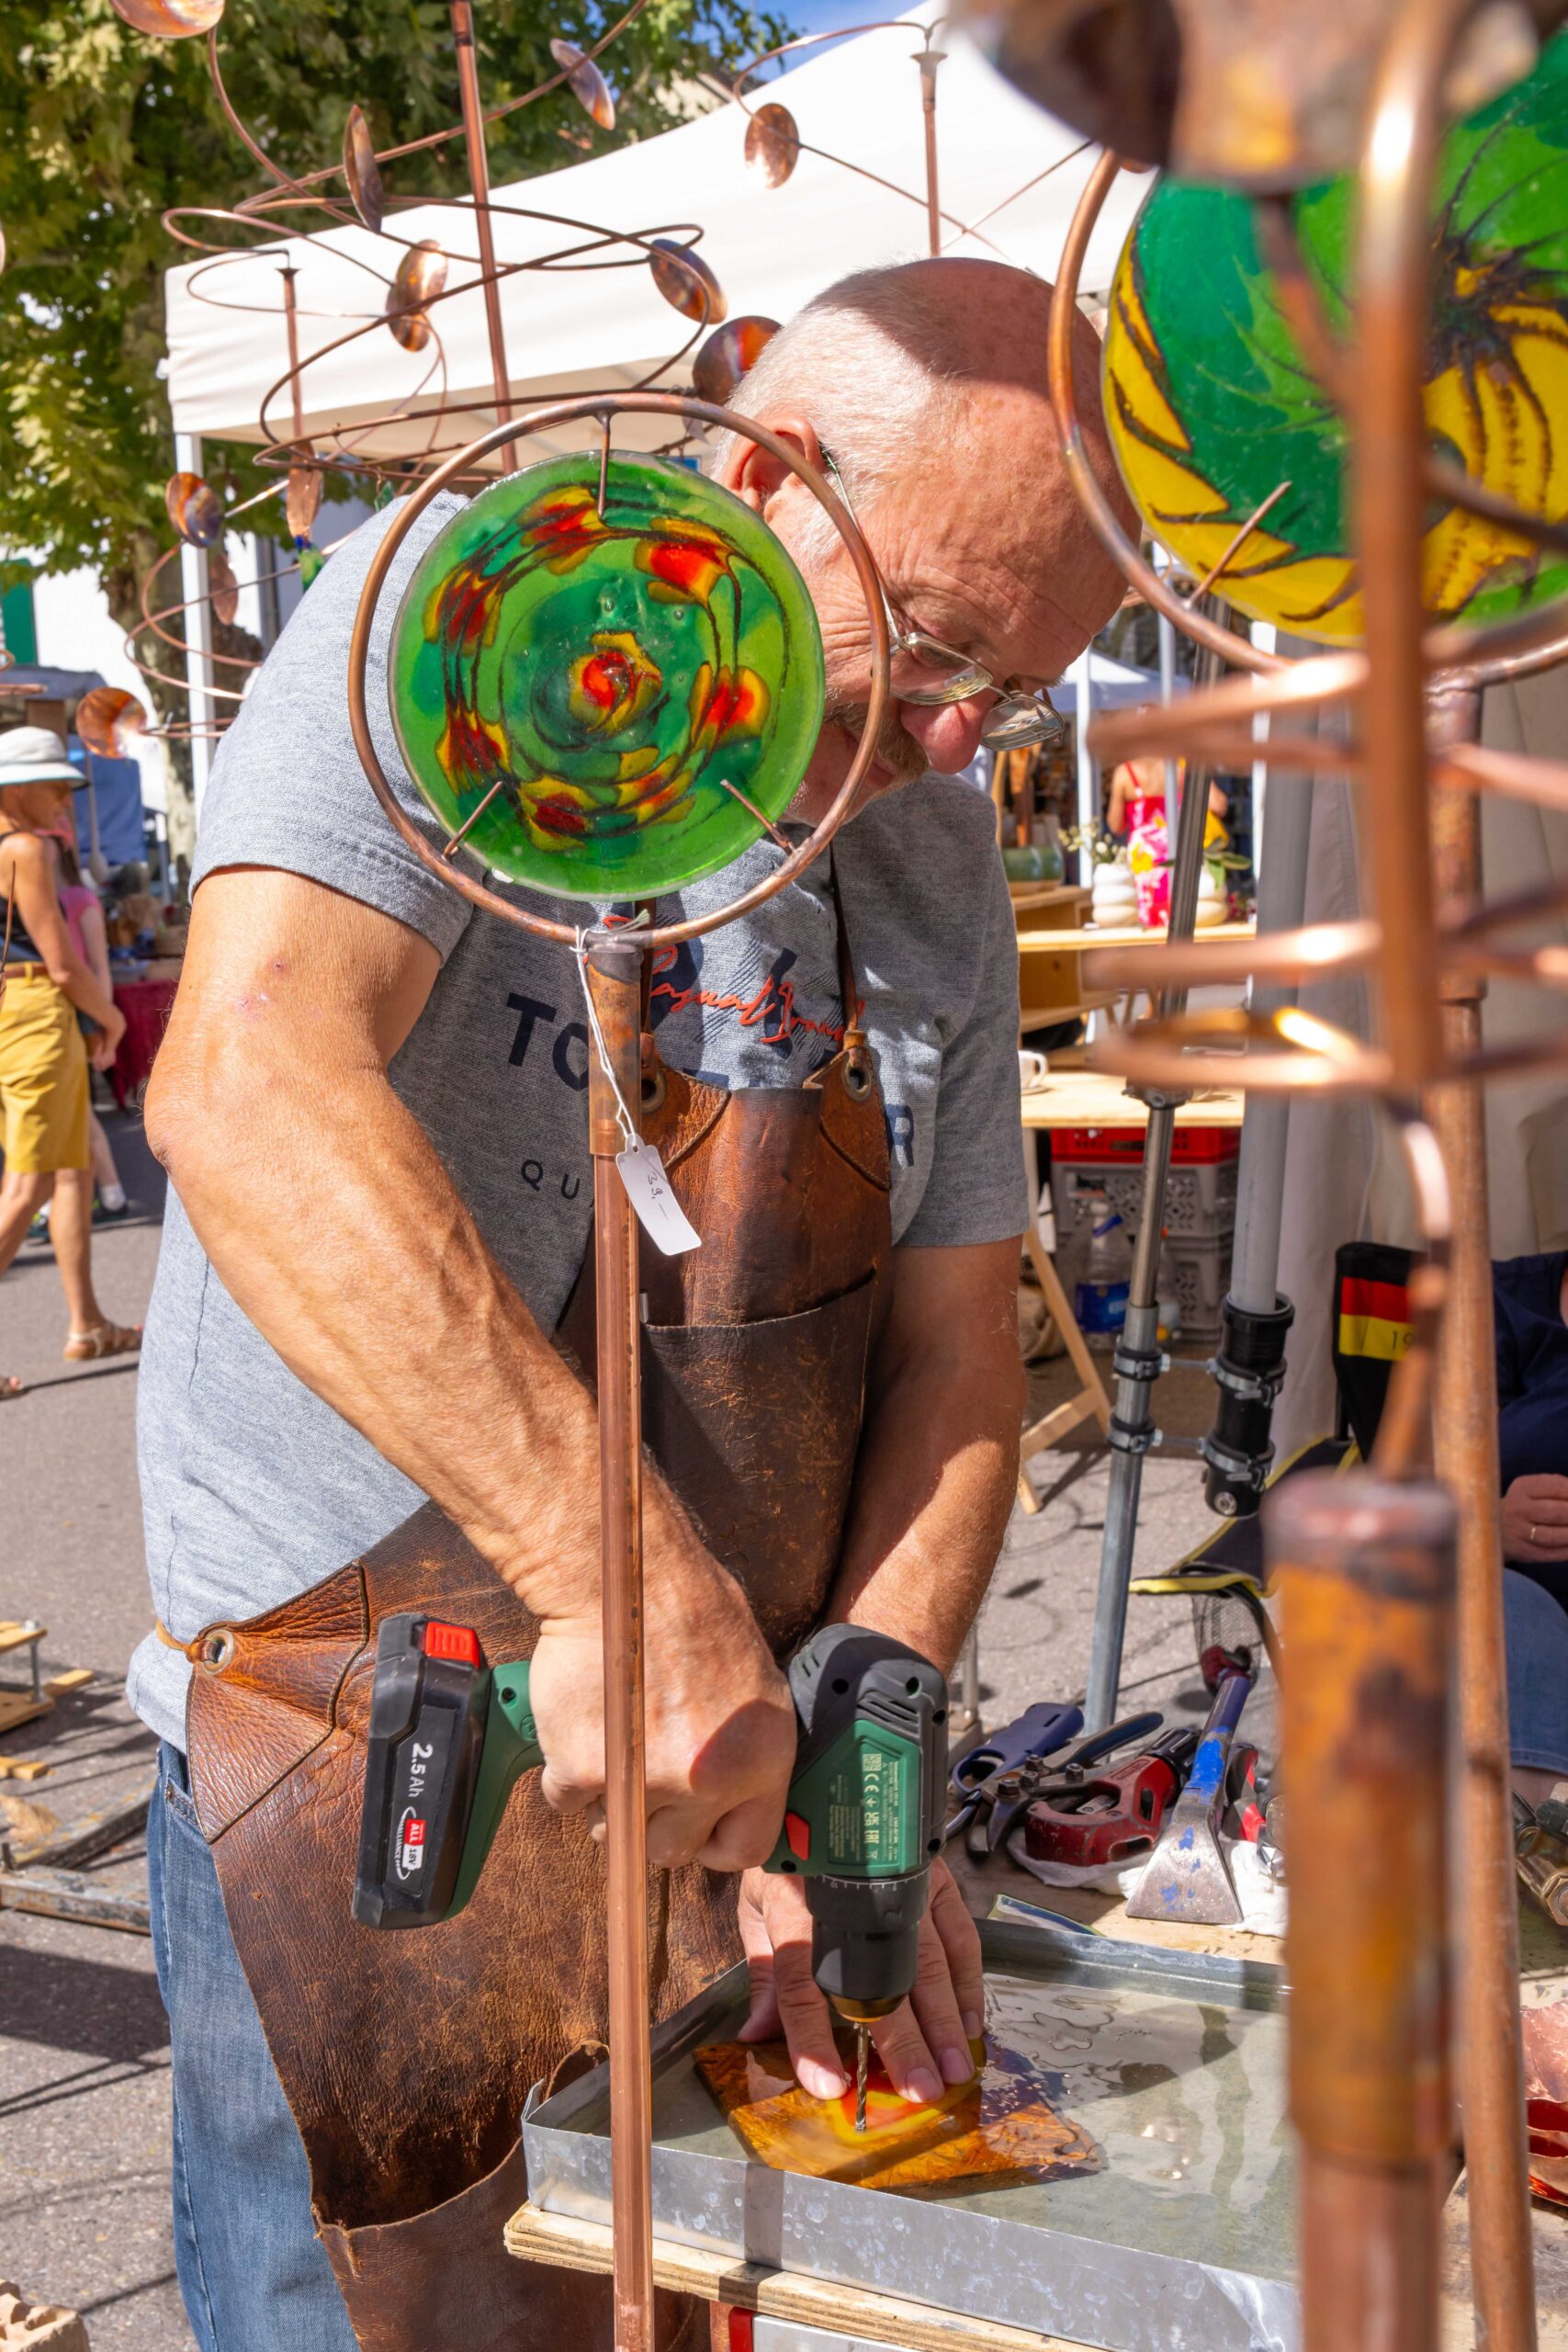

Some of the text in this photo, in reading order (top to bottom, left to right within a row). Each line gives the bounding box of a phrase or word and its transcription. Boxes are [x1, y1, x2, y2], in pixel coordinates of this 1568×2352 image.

[506, 992, 589, 1091] TO
[520, 1159, 581, 1201] QU
[409, 1823, 420, 1843] ALL
[408, 1848, 418, 1866] 18V
